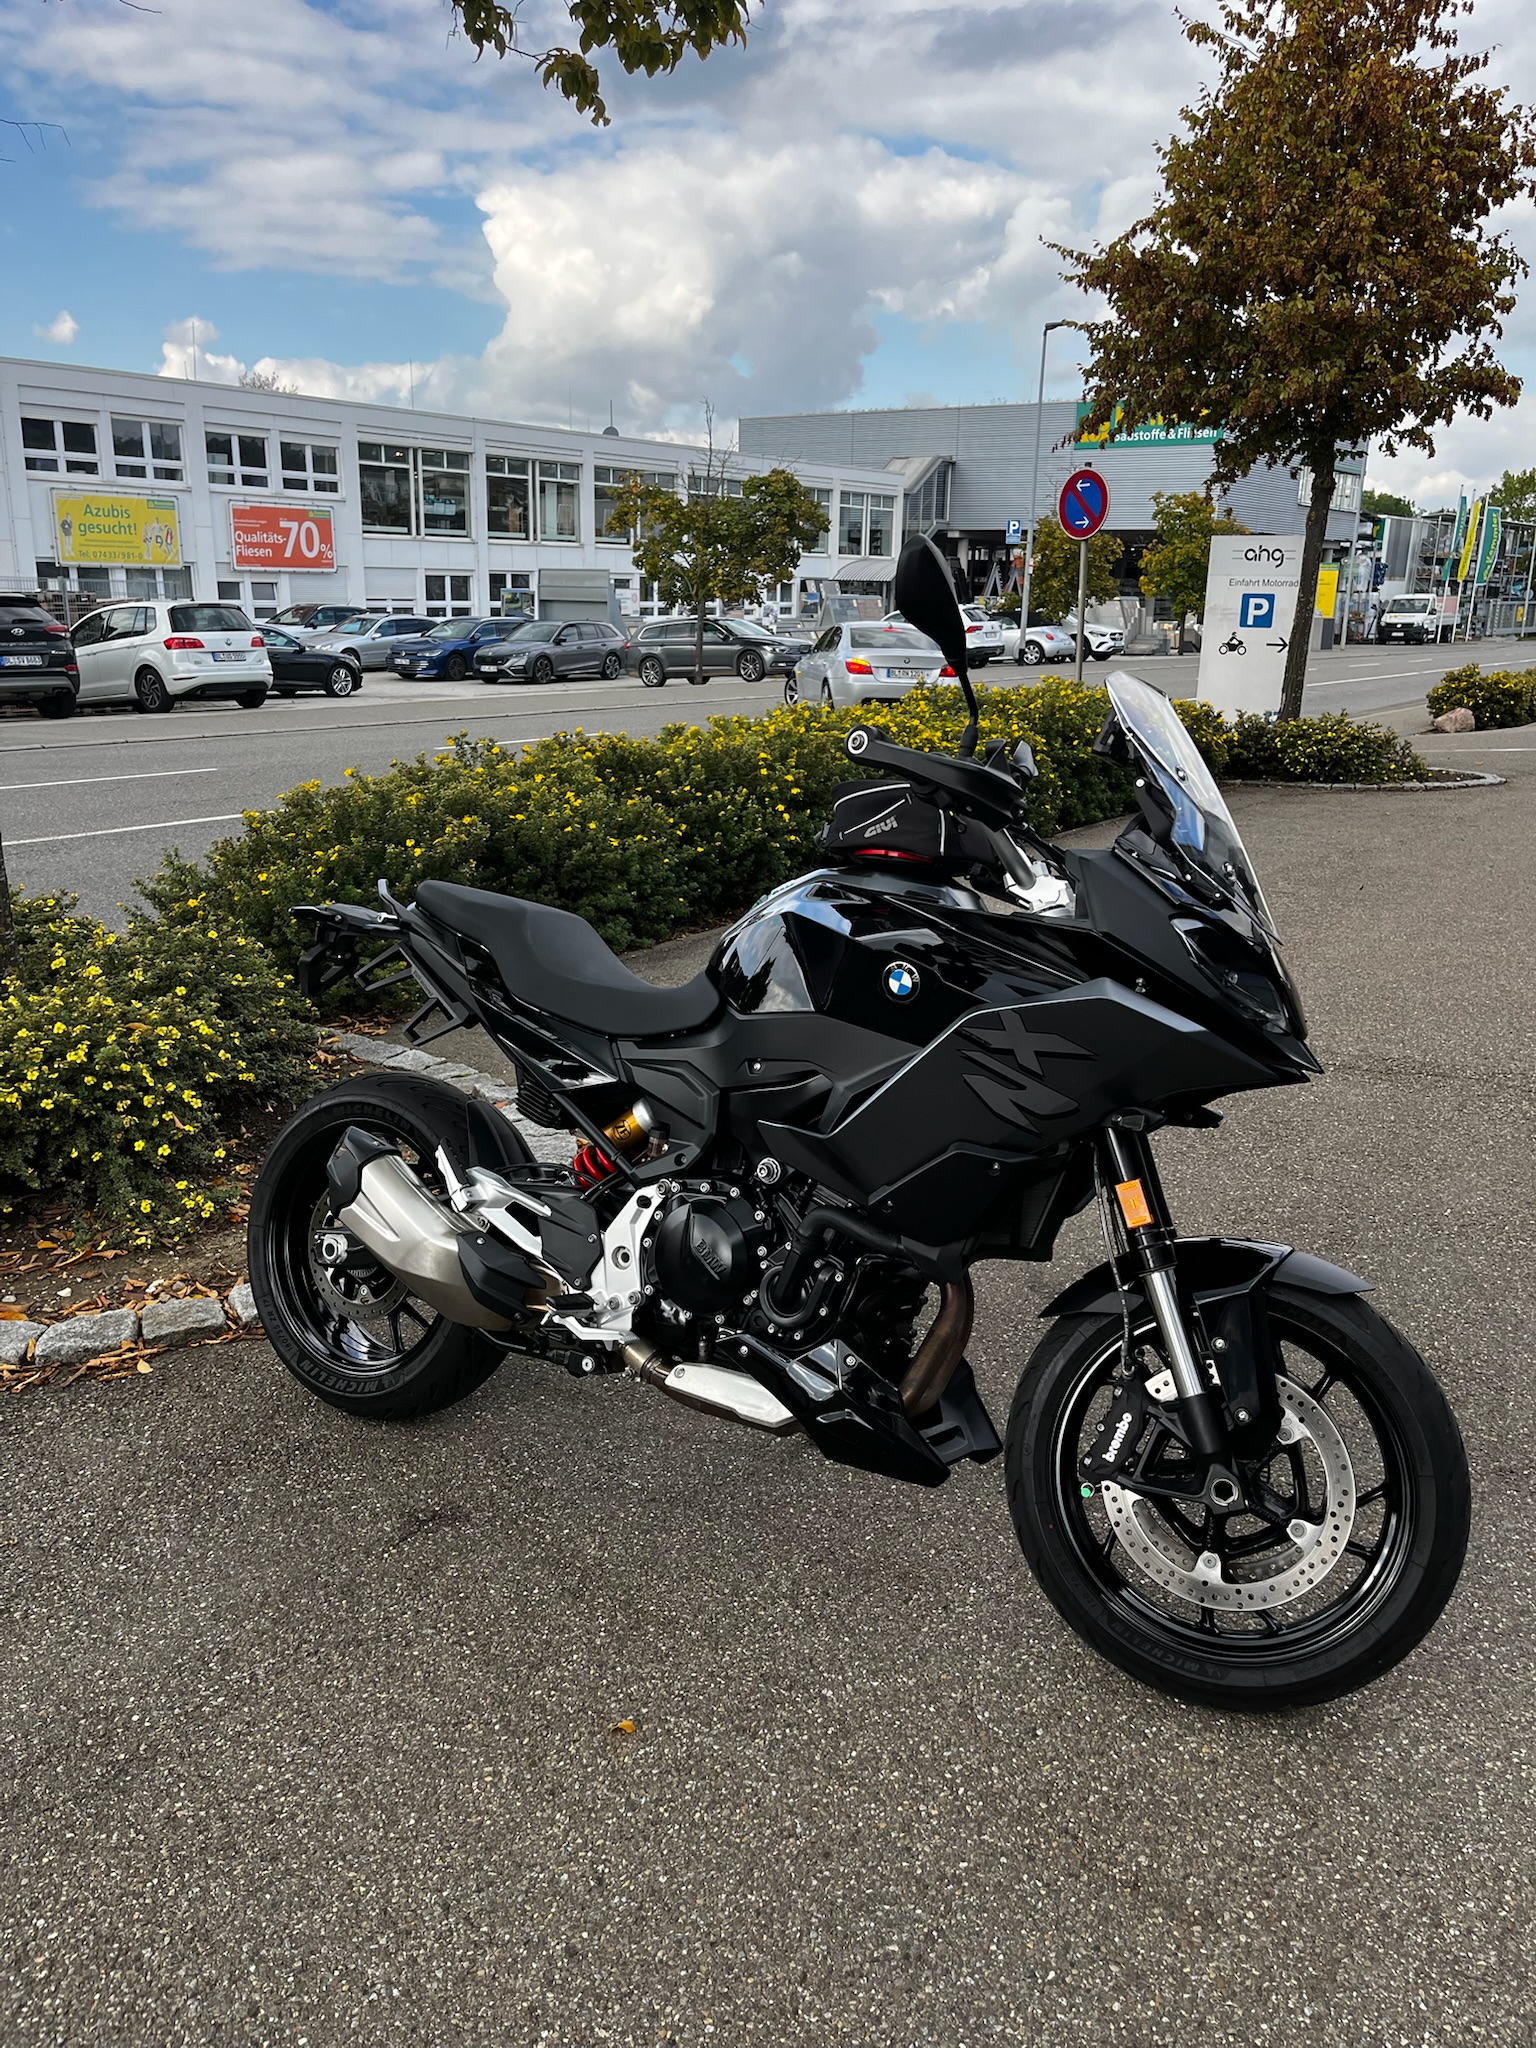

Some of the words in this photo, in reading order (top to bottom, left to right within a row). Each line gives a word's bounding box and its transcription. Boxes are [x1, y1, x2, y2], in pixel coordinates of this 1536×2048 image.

[1167, 428, 1176, 440] &
[1178, 426, 1217, 439] Flisen
[83, 503, 131, 519] Azubis
[78, 521, 137, 536] gesucht!
[1010, 520, 1019, 534] P
[235, 530, 287, 544] Qualitäts-
[236, 545, 272, 557] Fliesen
[1244, 545, 1284, 568] ahg
[1229, 578, 1260, 587] Einfahrt
[1262, 579, 1299, 587] Motorrad
[1247, 597, 1269, 625] P
[864, 815, 898, 838] GIVI
[696, 1238, 727, 1273] BMW
[299, 1361, 379, 1392] MICHELIN
[1102, 1412, 1132, 1462] brembo
[1111, 1622, 1200, 1671] MICHELIN
